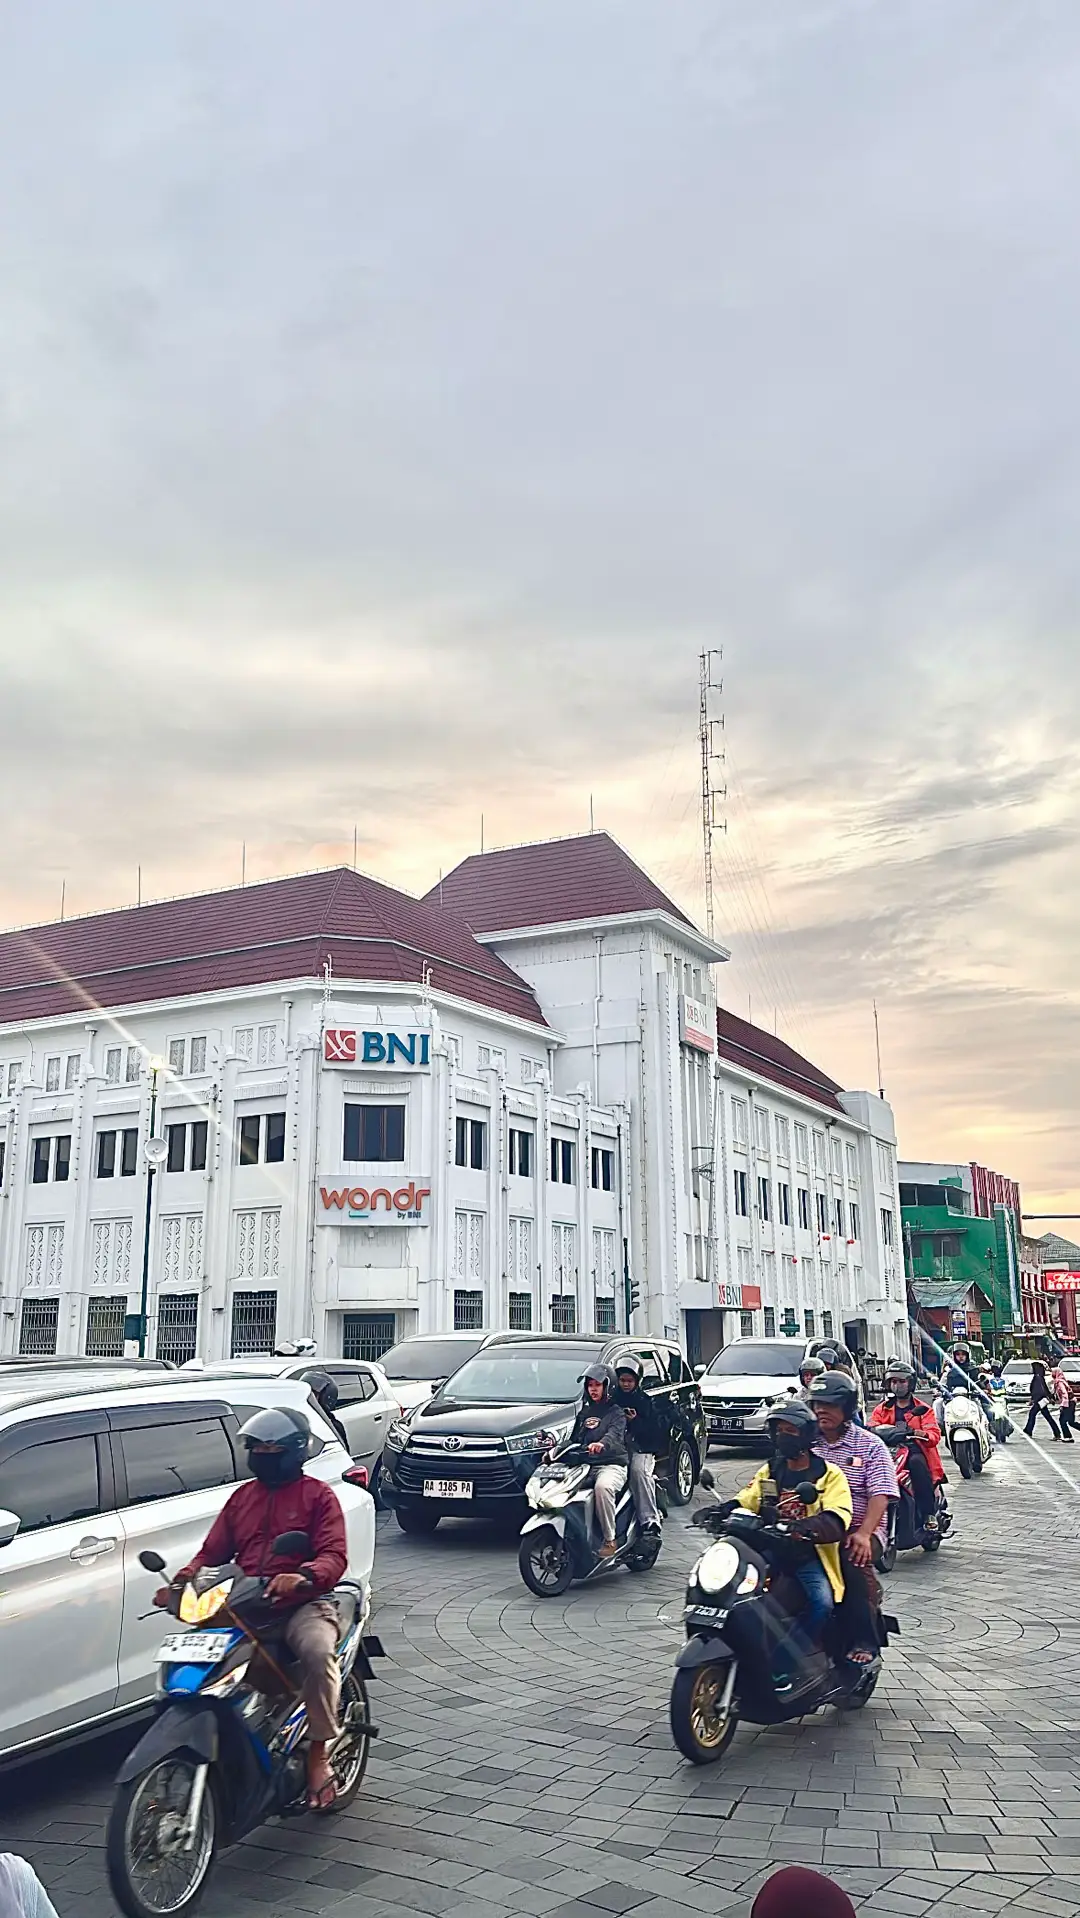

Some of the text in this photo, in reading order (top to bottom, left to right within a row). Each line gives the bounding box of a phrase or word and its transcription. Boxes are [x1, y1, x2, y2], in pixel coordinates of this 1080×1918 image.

[693, 1007, 708, 1029] BNI
[361, 1031, 430, 1064] BNI
[320, 1182, 430, 1210] wondr
[397, 1211, 422, 1220] by BNI
[726, 1286, 741, 1306] BNI
[425, 1481, 470, 1492] AA 1185 PA
